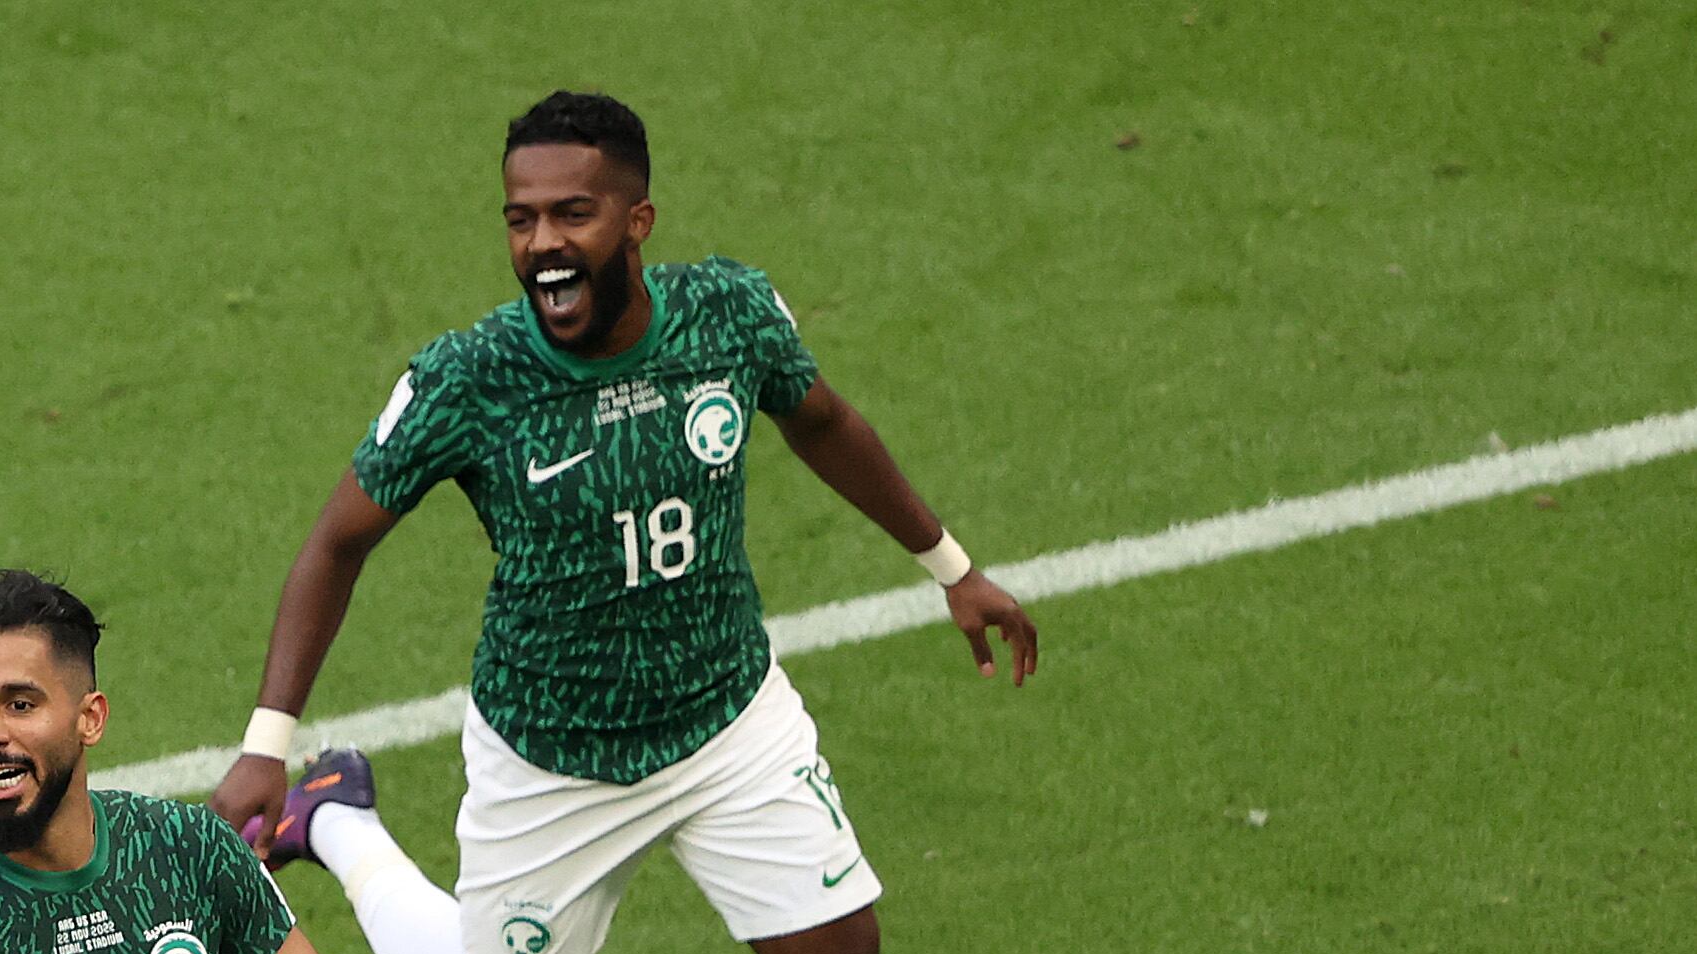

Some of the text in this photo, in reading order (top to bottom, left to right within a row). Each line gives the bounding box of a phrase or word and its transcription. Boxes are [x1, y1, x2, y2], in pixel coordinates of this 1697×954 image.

[612, 496, 695, 587] 18
[56, 920, 116, 945] 22 NOV 2022
[58, 909, 109, 932] ARG VS KSA
[85, 931, 125, 952] STADIUM
